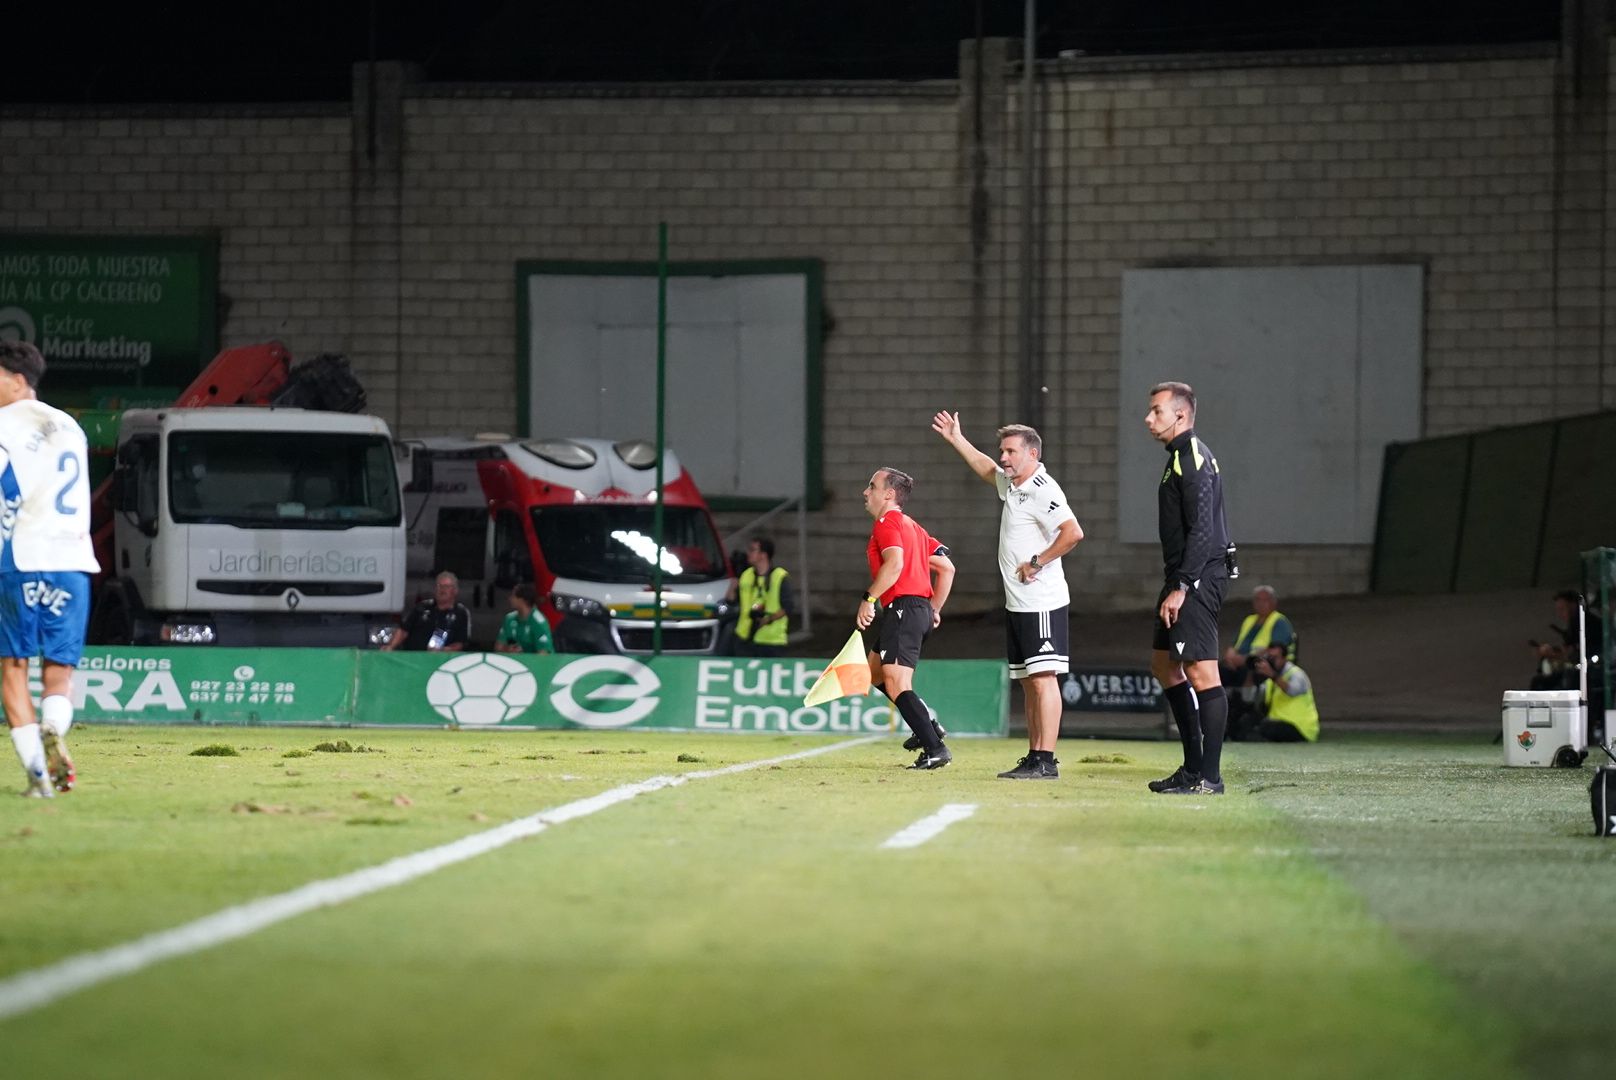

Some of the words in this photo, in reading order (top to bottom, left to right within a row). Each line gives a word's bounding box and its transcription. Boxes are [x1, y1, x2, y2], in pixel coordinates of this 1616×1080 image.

[47, 256, 90, 276] TODA
[97, 257, 170, 277] NUESTRA
[24, 281, 43, 301] AL
[50, 281, 71, 302] CP
[77, 279, 162, 303] CACEREÑO
[42, 314, 95, 335] Extre
[42, 336, 152, 366] Marketing
[55, 451, 79, 515] 2
[209, 550, 378, 575] JardineríaSara
[225, 681, 245, 692] 23
[250, 682, 270, 692] 22
[275, 682, 295, 692] 28
[1080, 674, 1163, 695] VERSUS
[189, 691, 220, 702] 637
[224, 693, 244, 703] 57
[249, 693, 269, 703] 47
